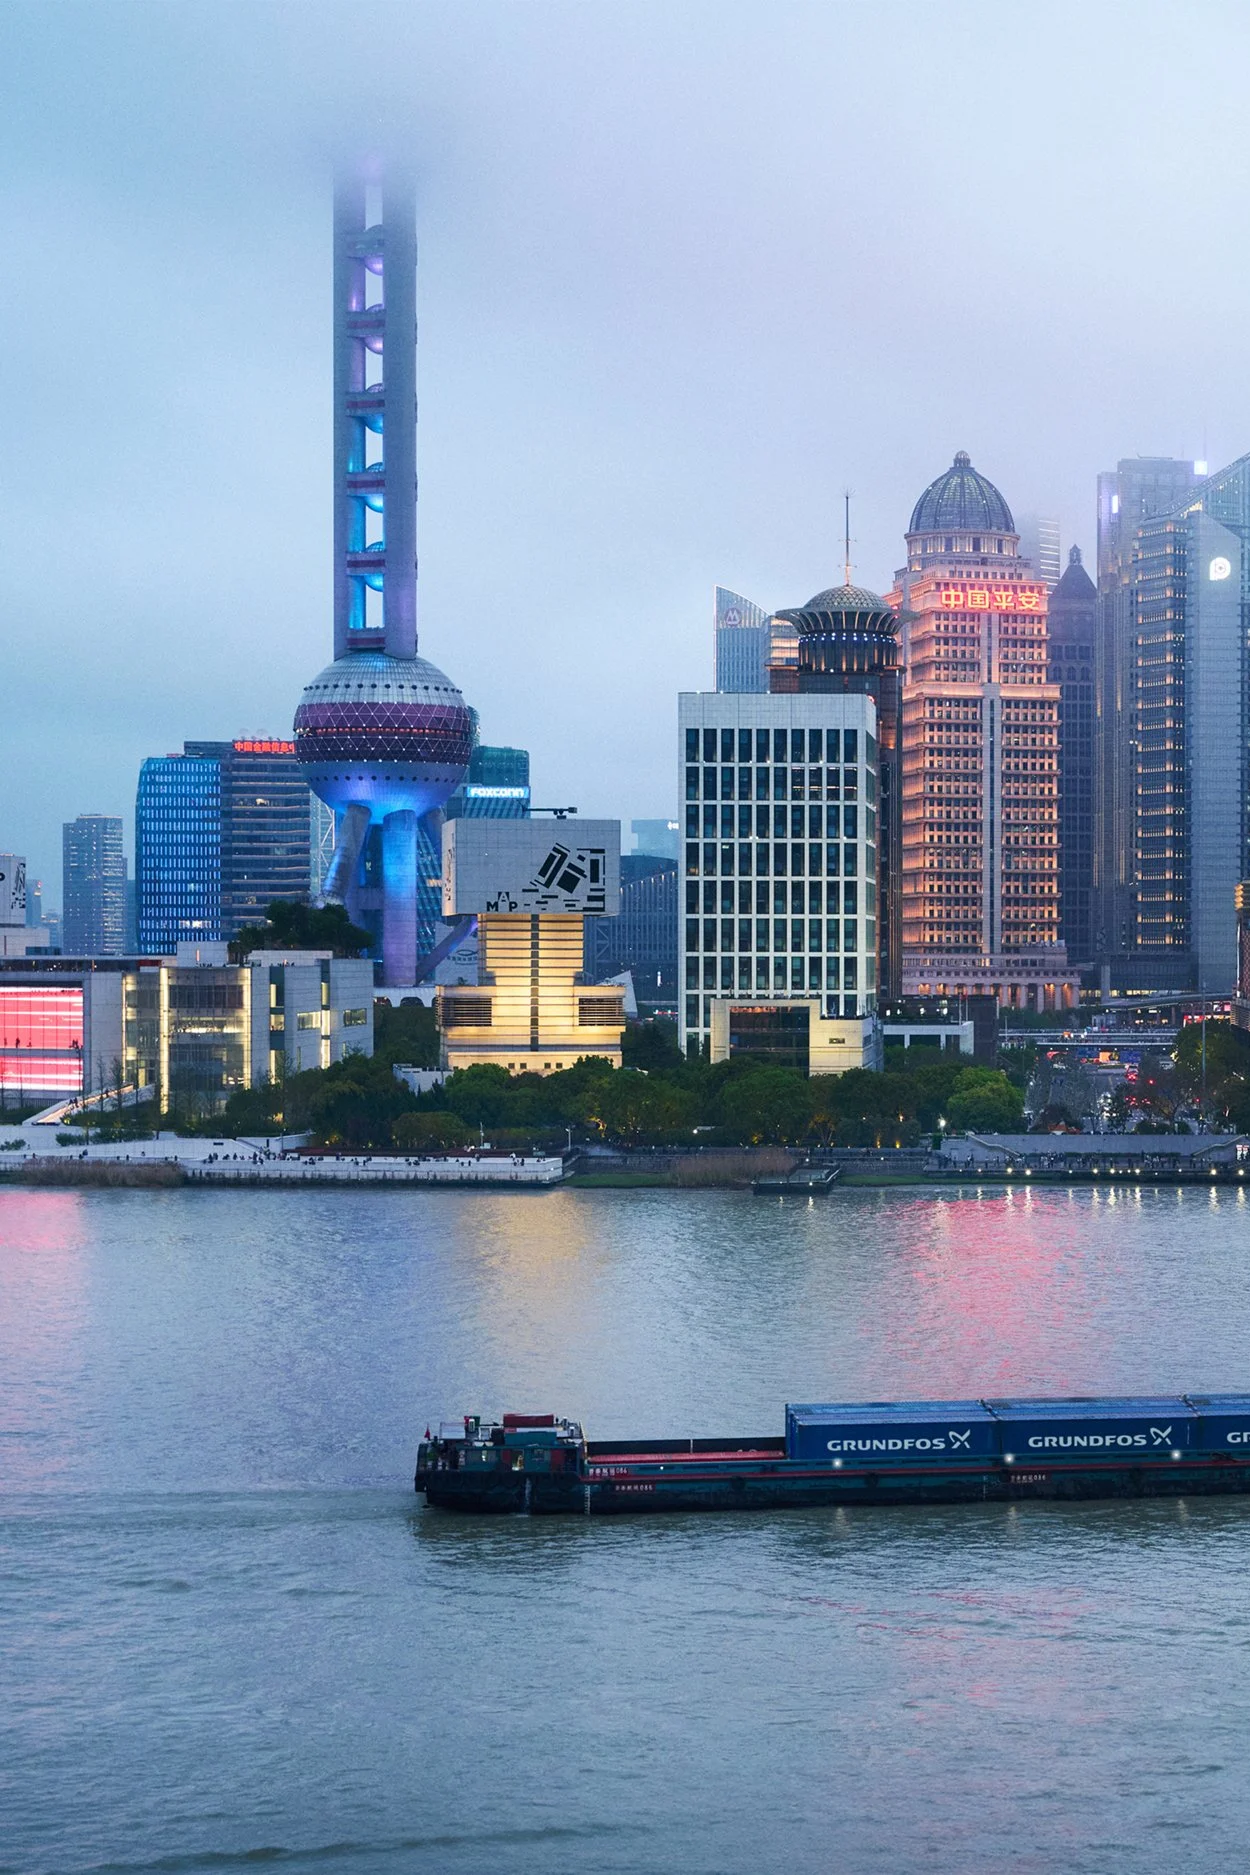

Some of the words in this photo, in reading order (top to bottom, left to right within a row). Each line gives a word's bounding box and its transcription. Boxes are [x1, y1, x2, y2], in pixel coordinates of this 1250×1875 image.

[941, 589, 1040, 609] 中国平安
[826, 1438, 946, 1451] GRUNDFOS
[1027, 1434, 1147, 1448] GRUNDFOS
